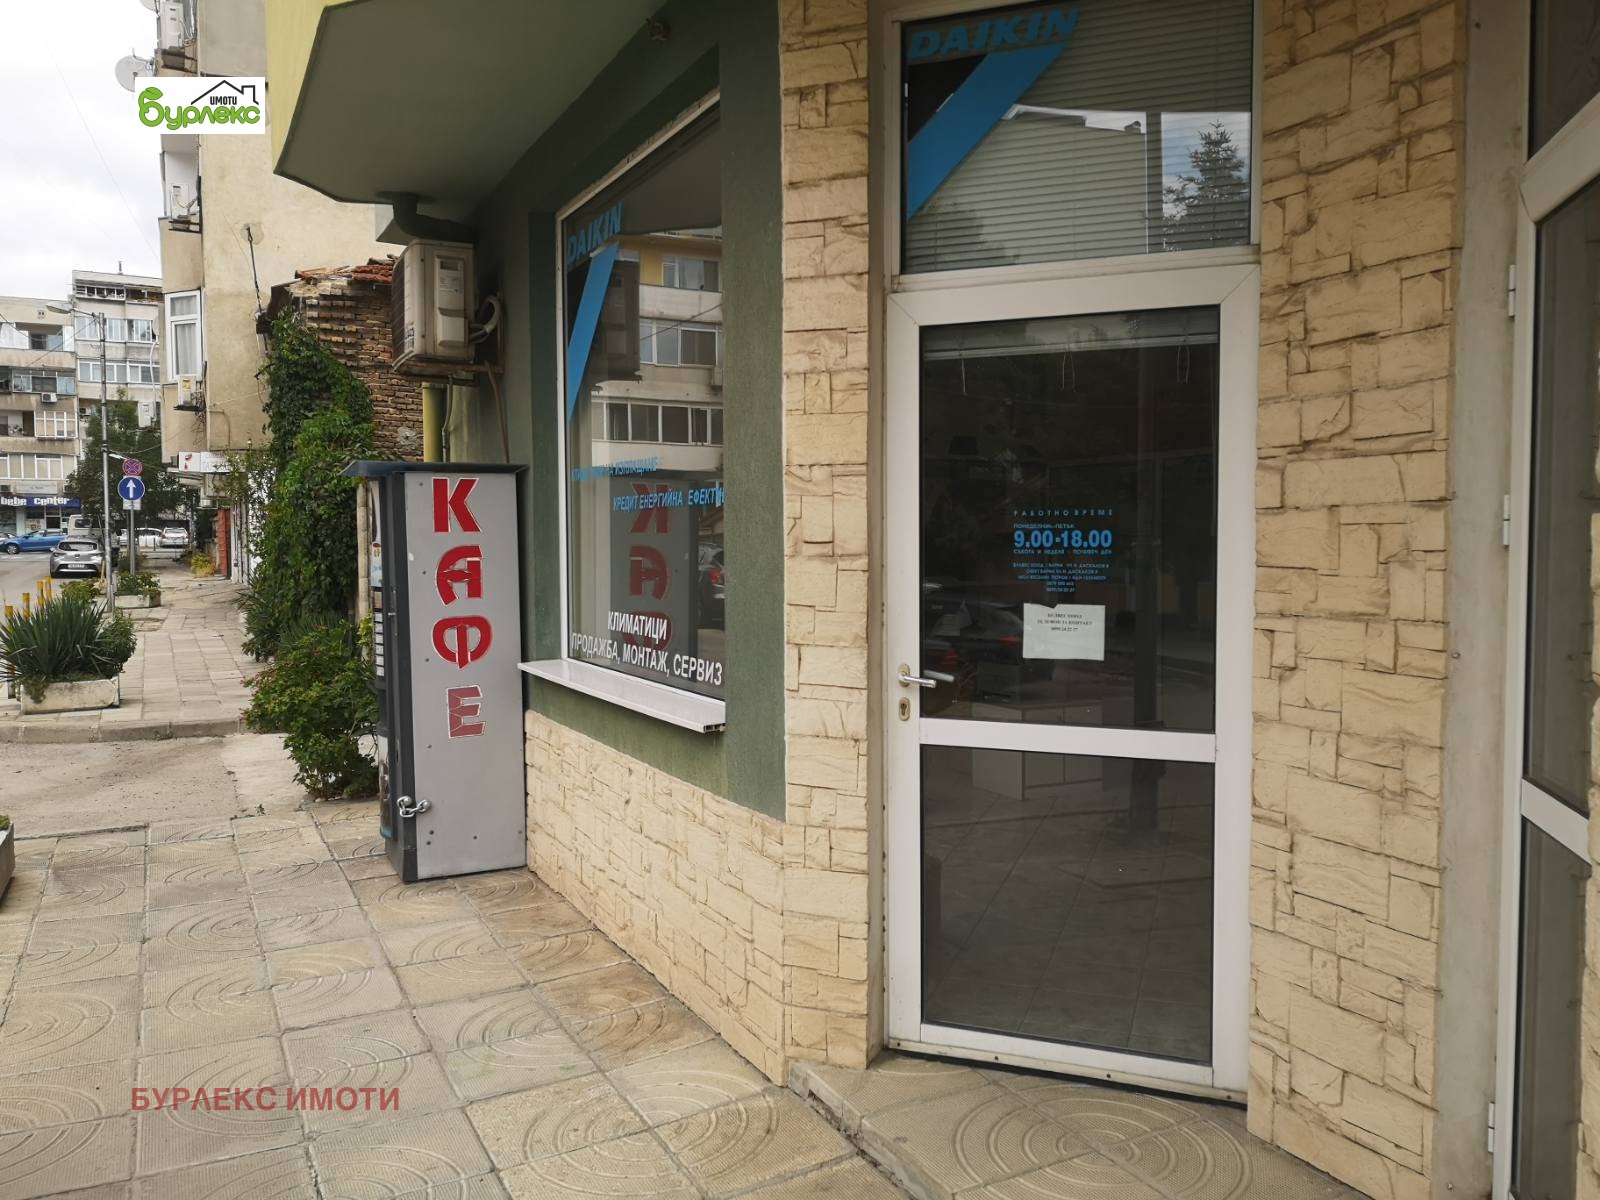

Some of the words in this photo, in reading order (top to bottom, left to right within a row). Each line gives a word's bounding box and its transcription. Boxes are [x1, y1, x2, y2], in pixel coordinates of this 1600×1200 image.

[907, 7, 1080, 59] DAIKIN
[566, 202, 623, 264] DAIKIN
[33, 496, 70, 506] center
[614, 495, 639, 512] КРЕДИТ
[639, 488, 683, 509] ЕНЕРГИЙНА
[432, 476, 493, 738] КАФЕ
[607, 611, 668, 644] КЛИМАТИЦИ
[571, 633, 620, 665] ПРОДАЖБА,
[622, 643, 670, 677] МОНТАЖ,
[673, 654, 723, 686] СЕРВИЗ
